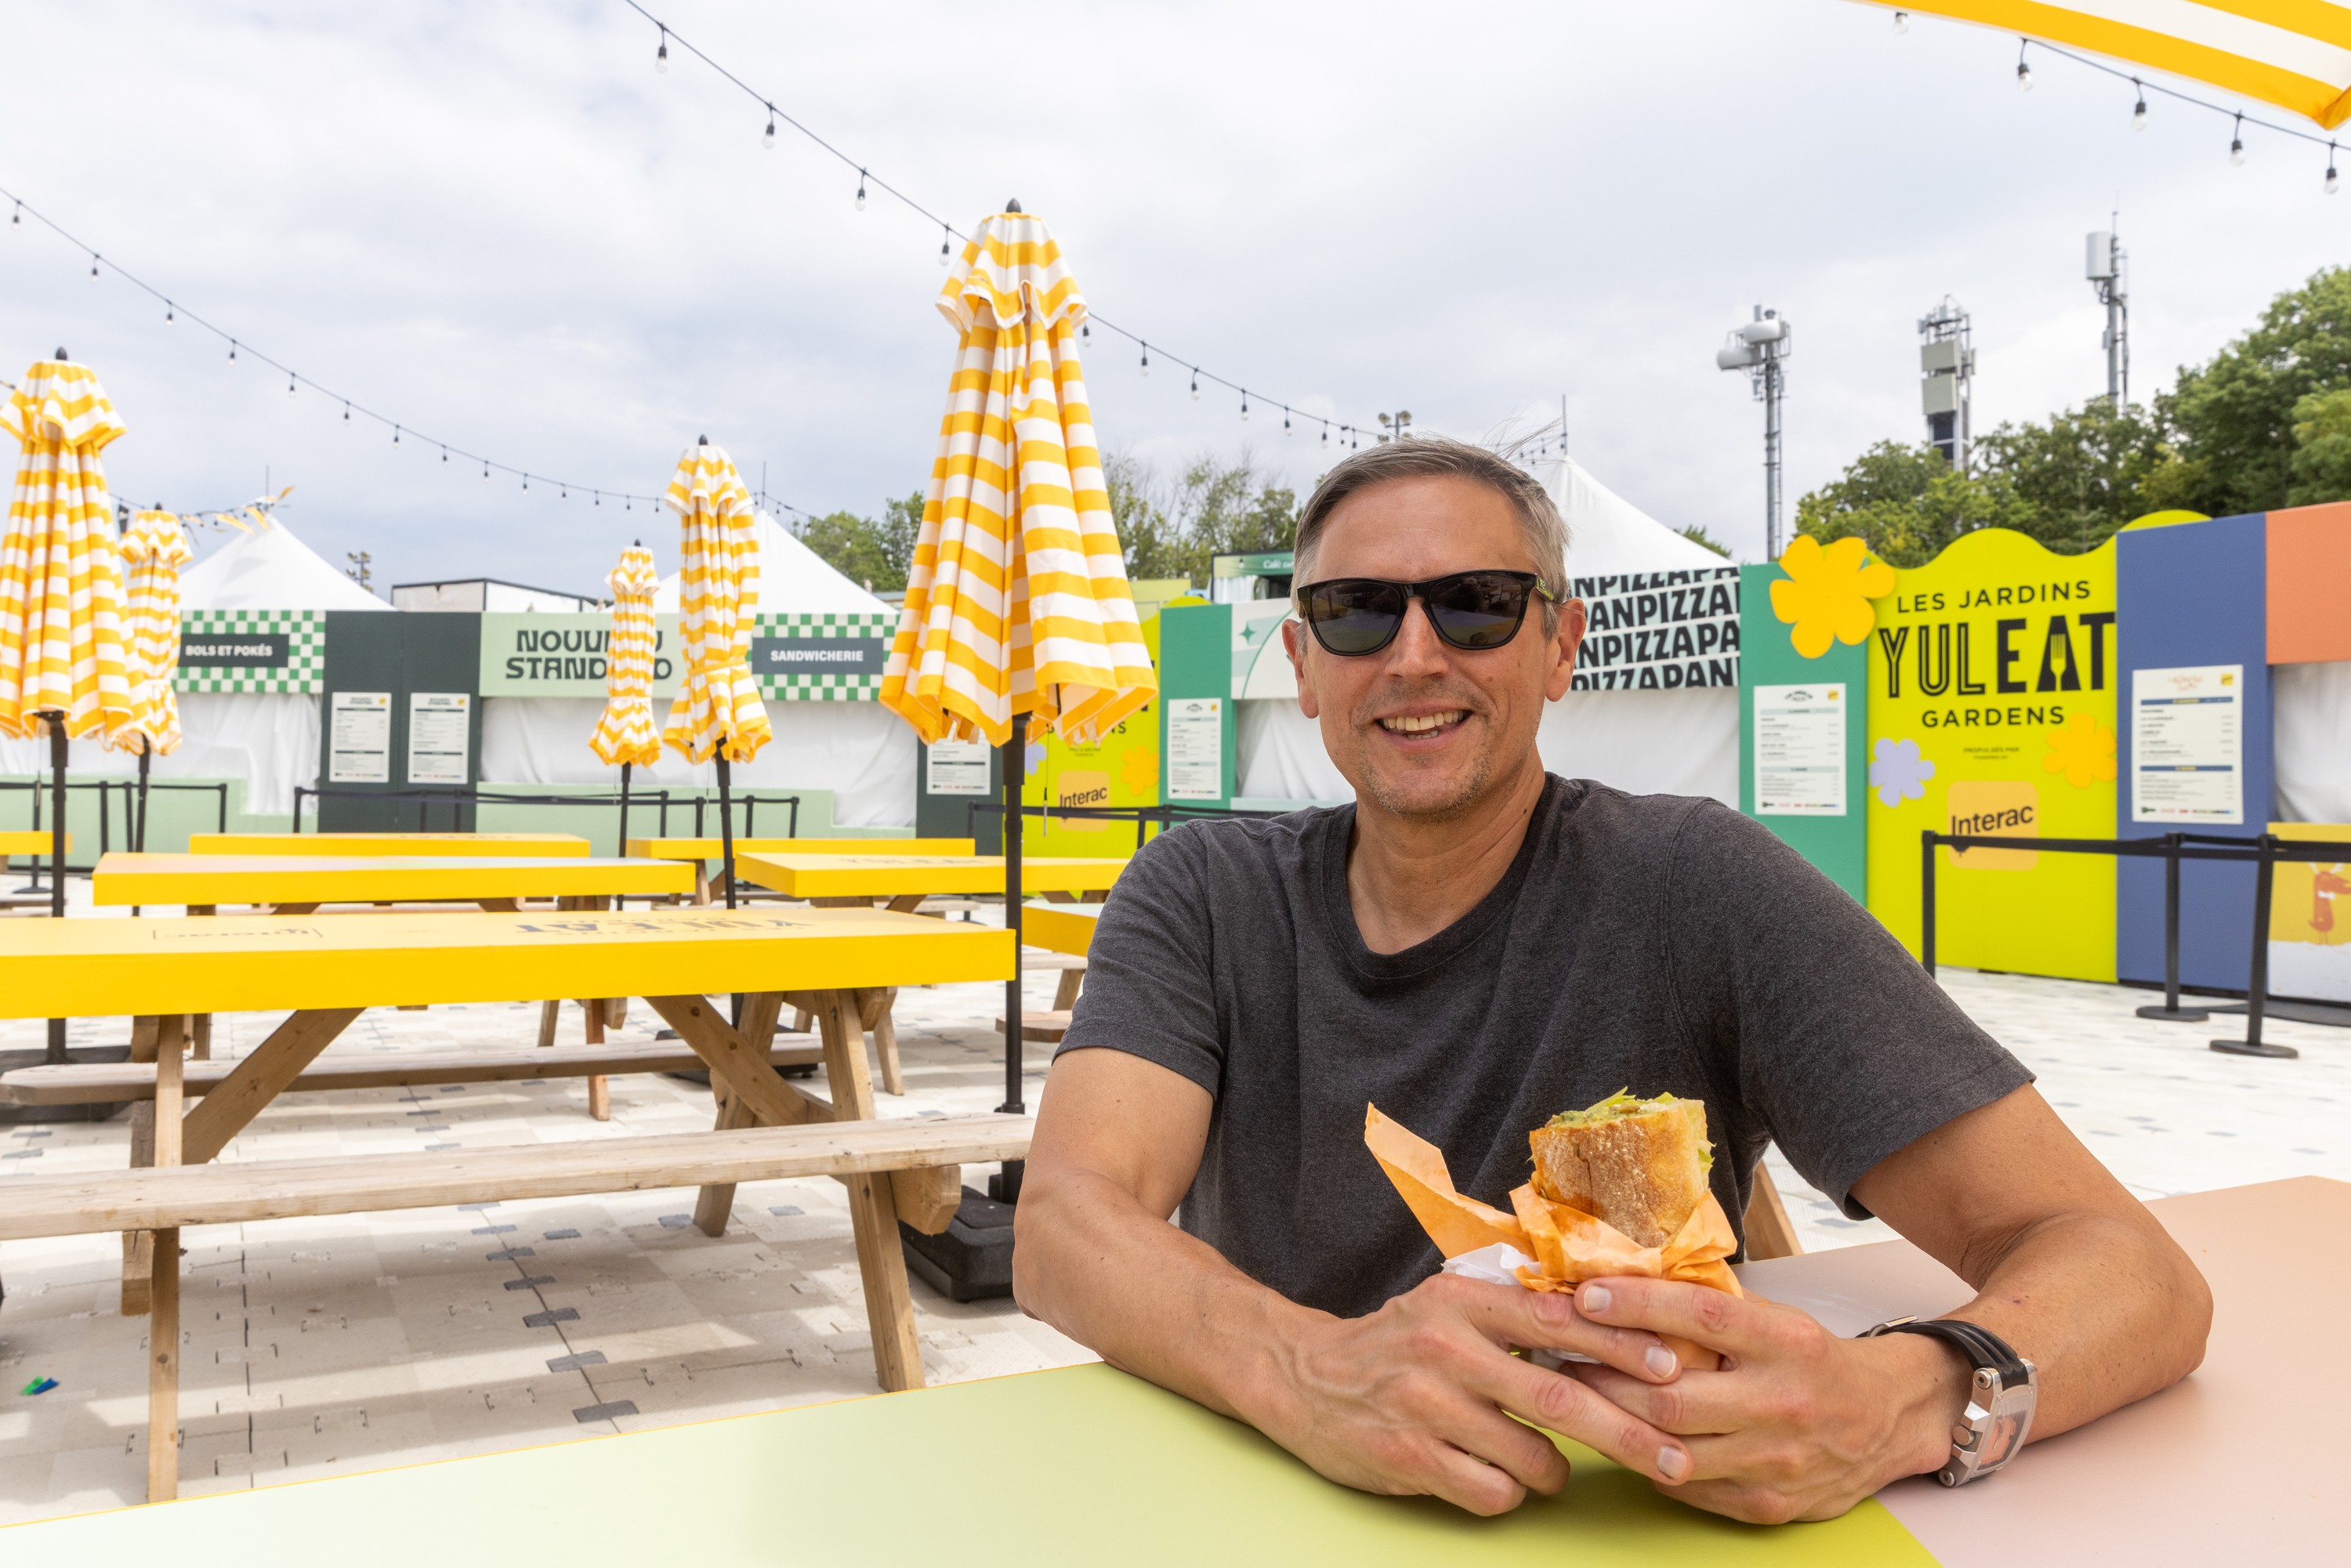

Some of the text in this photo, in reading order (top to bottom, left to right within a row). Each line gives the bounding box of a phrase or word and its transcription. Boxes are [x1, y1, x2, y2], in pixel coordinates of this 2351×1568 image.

[1897, 581, 2091, 614] LES JARDINS
[185, 643, 273, 657] BOLS ET POKÉS
[516, 629, 663, 652] NOUV
[770, 650, 864, 661] SANDWICHERIE
[505, 657, 672, 679] STANDD
[1922, 706, 2064, 728] GARDENS
[1060, 787, 1108, 808] Interac
[1951, 806, 2034, 836] Interac
